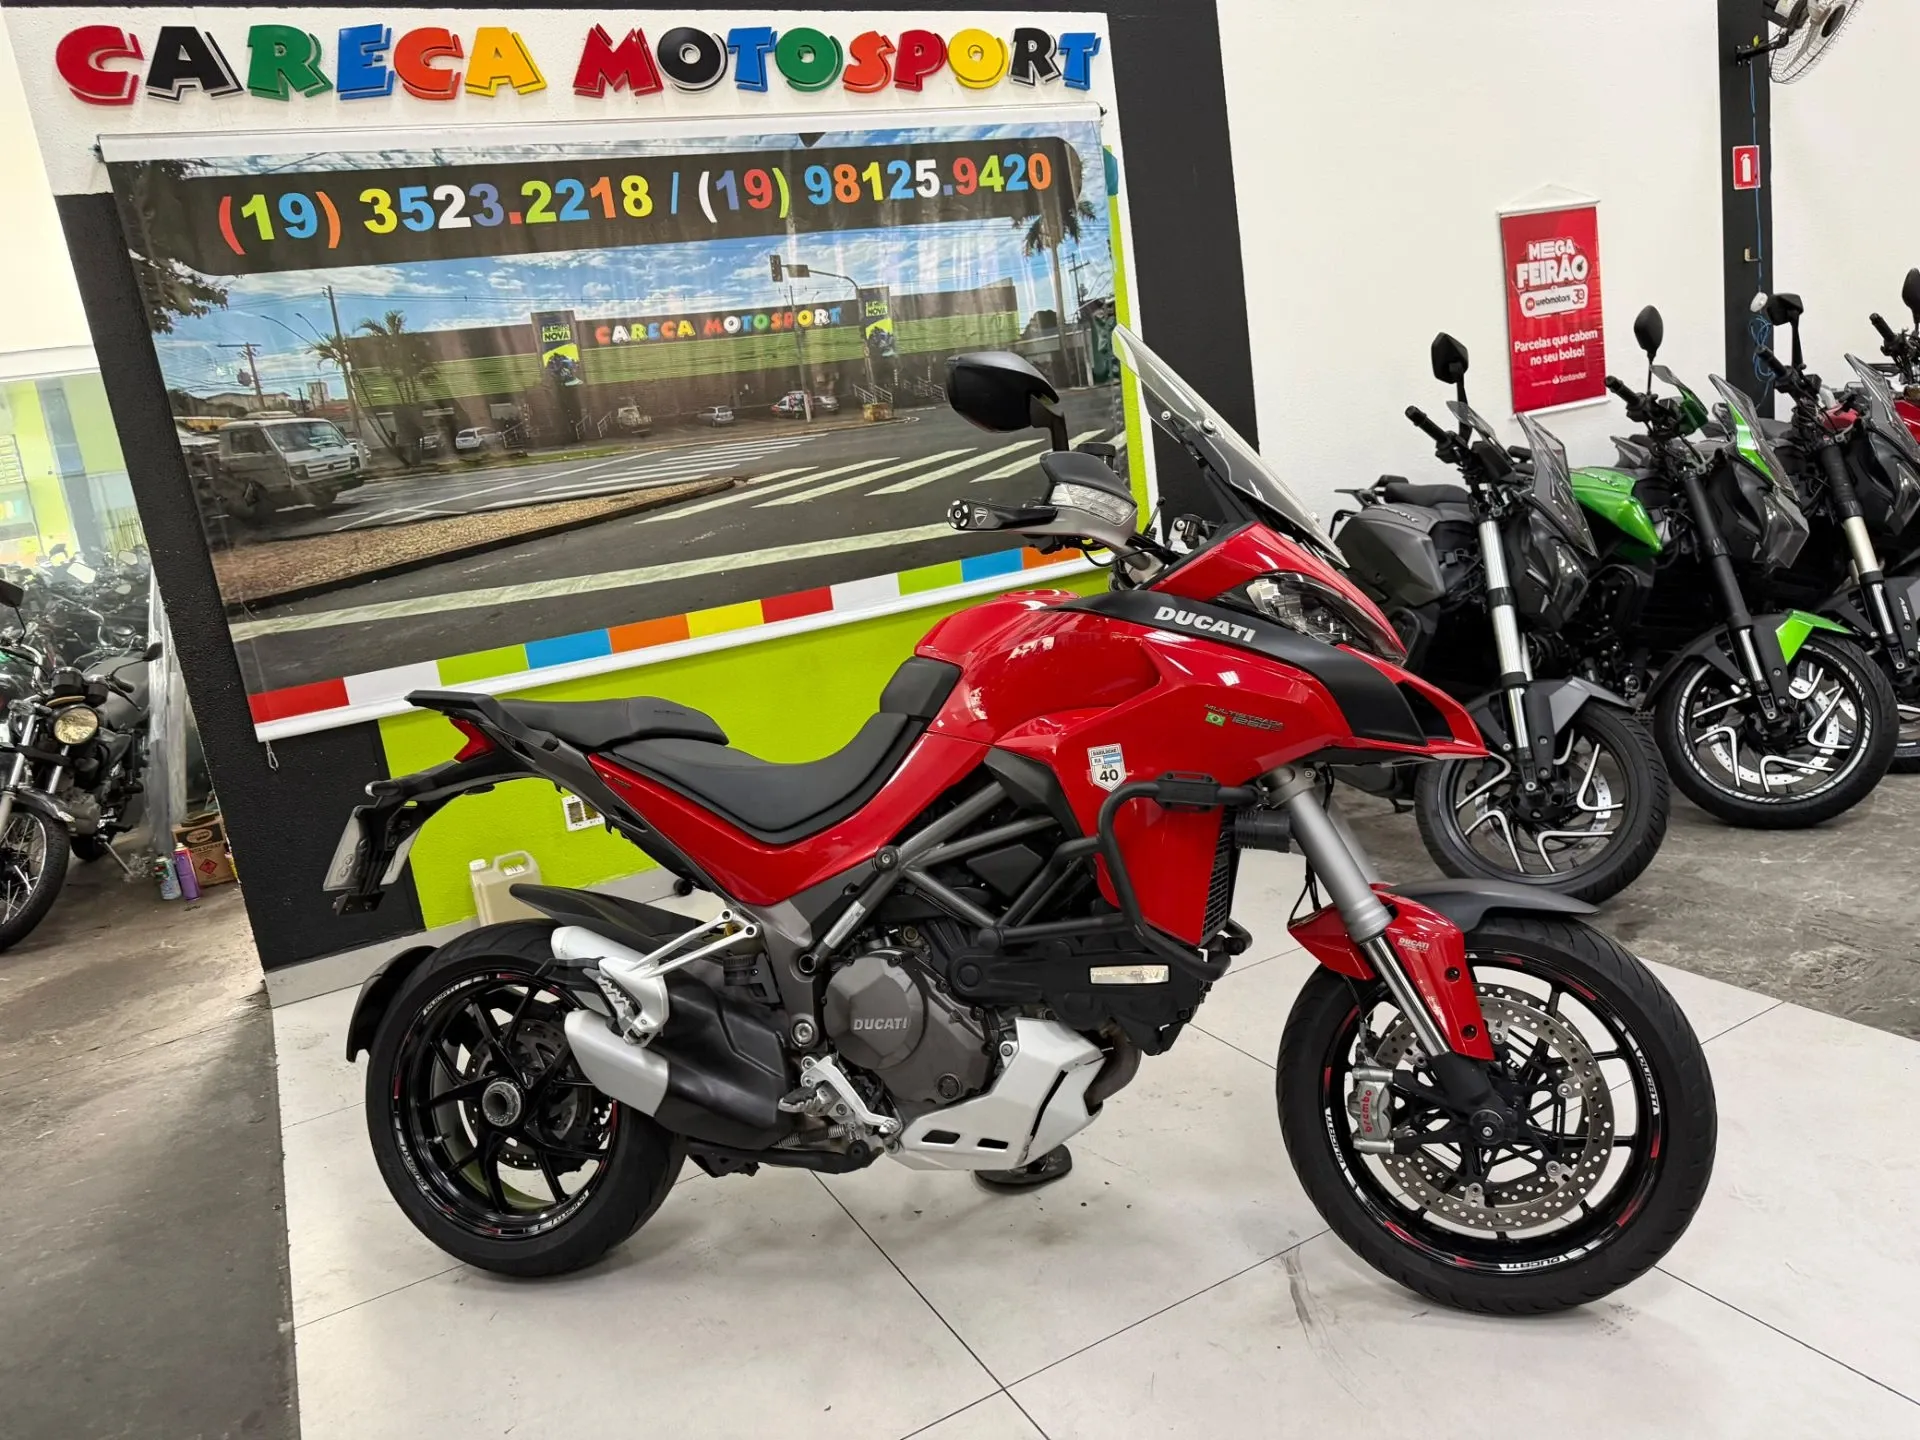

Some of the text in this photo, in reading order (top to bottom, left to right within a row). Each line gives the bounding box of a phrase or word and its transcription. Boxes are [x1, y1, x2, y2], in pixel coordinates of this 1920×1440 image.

[55, 23, 1100, 105] CARECA MOTOSPORT
[218, 190, 342, 255] (19)
[359, 175, 653, 234] 3523.2218
[698, 167, 790, 223] (19)
[804, 153, 1052, 205] 98125.9420
[1528, 239, 1576, 260] MEGA
[1516, 254, 1588, 288] FEIRÃO
[544, 331, 570, 341] NOVA
[595, 306, 841, 345] CARECA MOTOSPORT
[1514, 330, 1598, 353] Parcelas que cabem
[1530, 344, 1585, 366] no seu bolso!
[1560, 371, 1587, 383] Santander
[1154, 606, 1256, 642] DUCATI
[1100, 769, 1118, 782] 40
[1399, 937, 1429, 950] DUCATI
[853, 1017, 908, 1030] DUCATI
[1638, 1056, 1659, 1109] DUCATI
[1361, 1090, 1373, 1133] brembo
[1507, 1256, 1561, 1270] DUCATI
